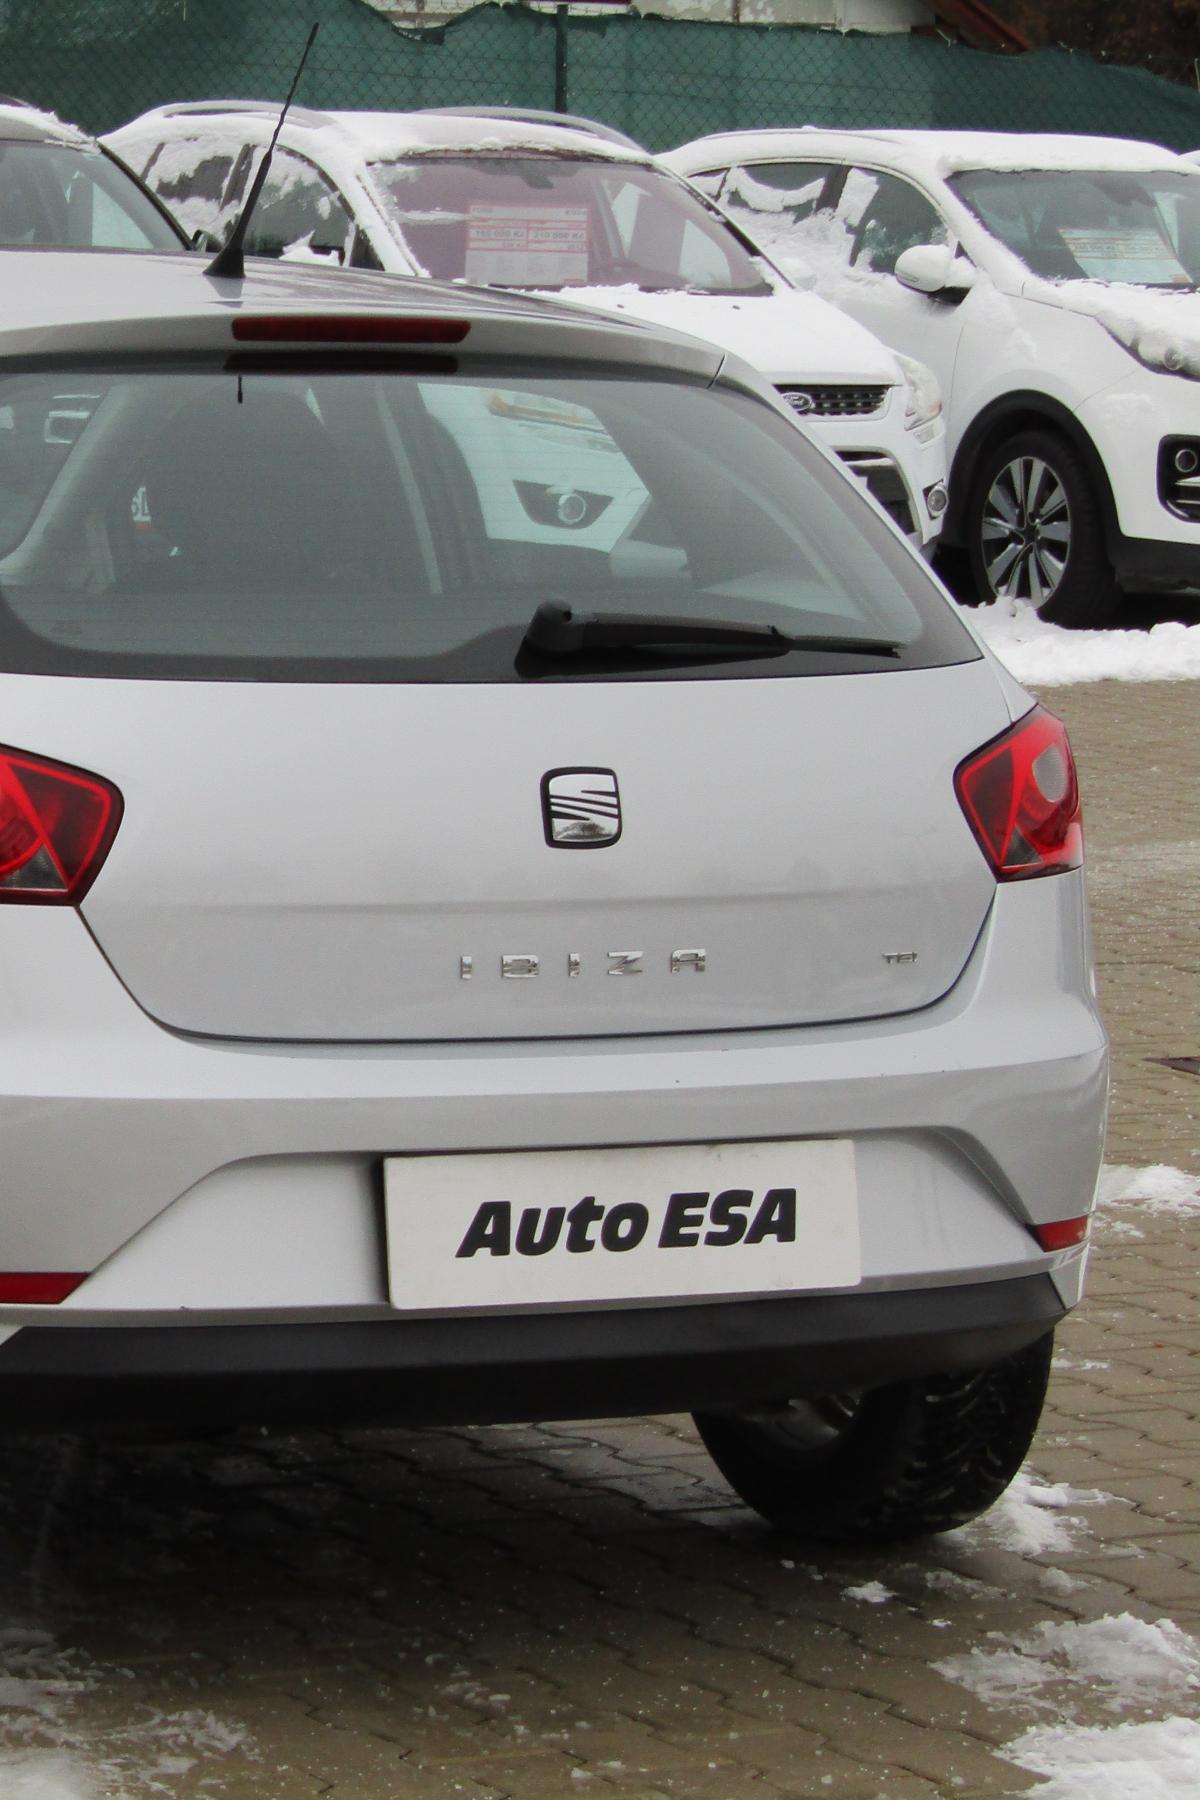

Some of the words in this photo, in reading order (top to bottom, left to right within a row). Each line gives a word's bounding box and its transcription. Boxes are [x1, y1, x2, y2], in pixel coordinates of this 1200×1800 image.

[460, 949, 706, 979] IBIZA
[455, 1196, 649, 1257] Auto
[657, 1188, 796, 1248] ESA
